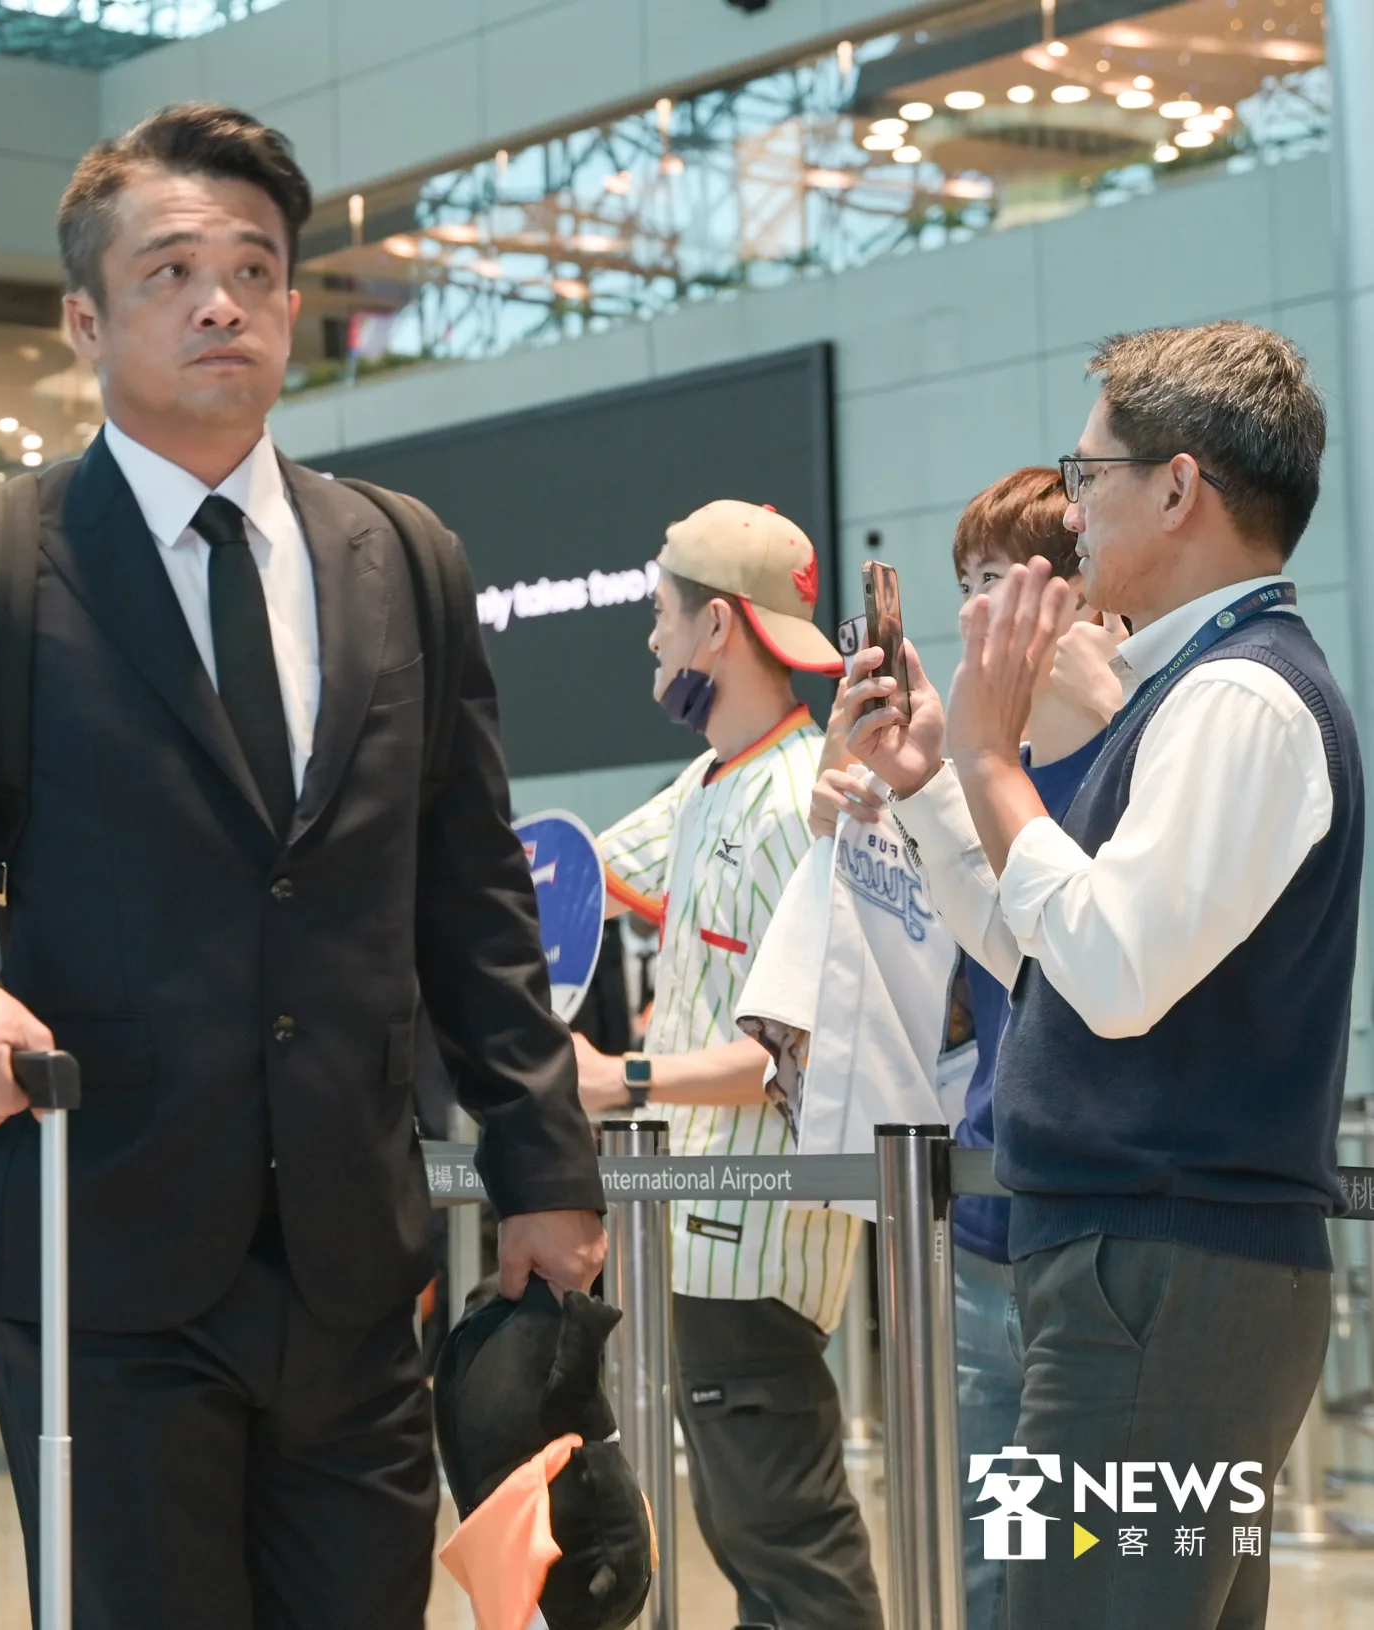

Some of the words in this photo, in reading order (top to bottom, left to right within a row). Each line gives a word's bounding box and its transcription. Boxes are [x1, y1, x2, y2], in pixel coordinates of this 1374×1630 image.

[1168, 639, 1200, 676] AGENCY
[599, 1165, 715, 1191] nternational
[720, 1166, 793, 1197] Airport
